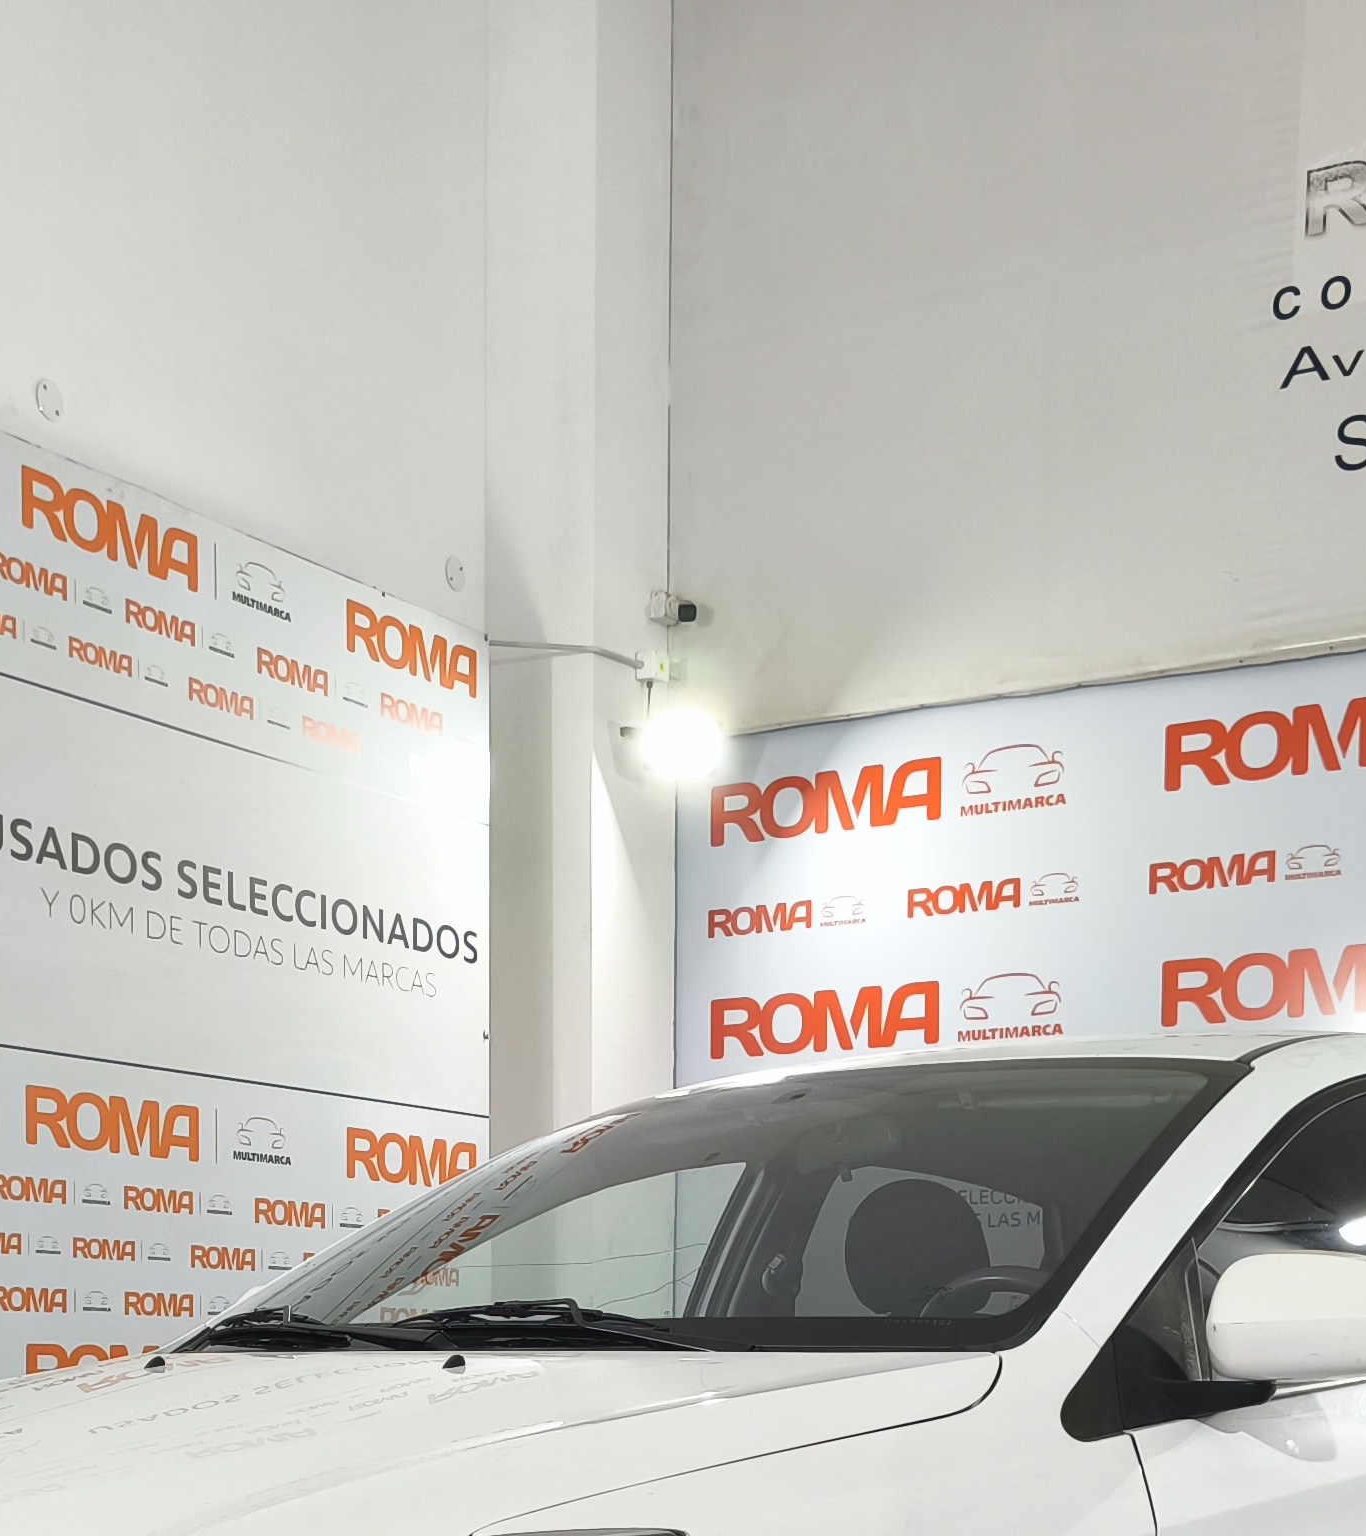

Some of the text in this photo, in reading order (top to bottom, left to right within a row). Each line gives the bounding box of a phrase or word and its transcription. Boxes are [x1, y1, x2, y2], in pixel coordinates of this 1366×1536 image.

[22, 466, 199, 592] ROMA
[127, 601, 195, 646] ROMA
[231, 590, 292, 623] MULTIMARCA
[69, 638, 132, 676] ROMA
[347, 600, 477, 699] ROMA
[258, 649, 328, 696] ROMA
[189, 679, 253, 719] ROMA
[380, 692, 444, 737] ROMA
[711, 757, 942, 846] ROMA
[960, 794, 1066, 817] MULTIMARCA
[1150, 851, 1276, 895] ROMA
[176, 858, 479, 964] SELECCIONADOS
[908, 878, 1021, 918] ROMA
[709, 901, 812, 938] ROMA
[41, 886, 60, 918] Y
[146, 909, 184, 946] DE
[192, 919, 285, 967] TODAS
[293, 942, 335, 977] LAS
[342, 953, 437, 998] MARCAS
[711, 982, 939, 1060] ROMA
[957, 1023, 1064, 1043] MULTIMARCA
[26, 1086, 199, 1163] ROMA
[232, 1150, 292, 1166] MULTIMARCA
[125, 1187, 193, 1214] ROMA
[255, 1198, 325, 1229] ROMA
[73, 1239, 135, 1261] ROMA
[191, 1246, 255, 1271] ROMA
[125, 1293, 193, 1317] ROMA
